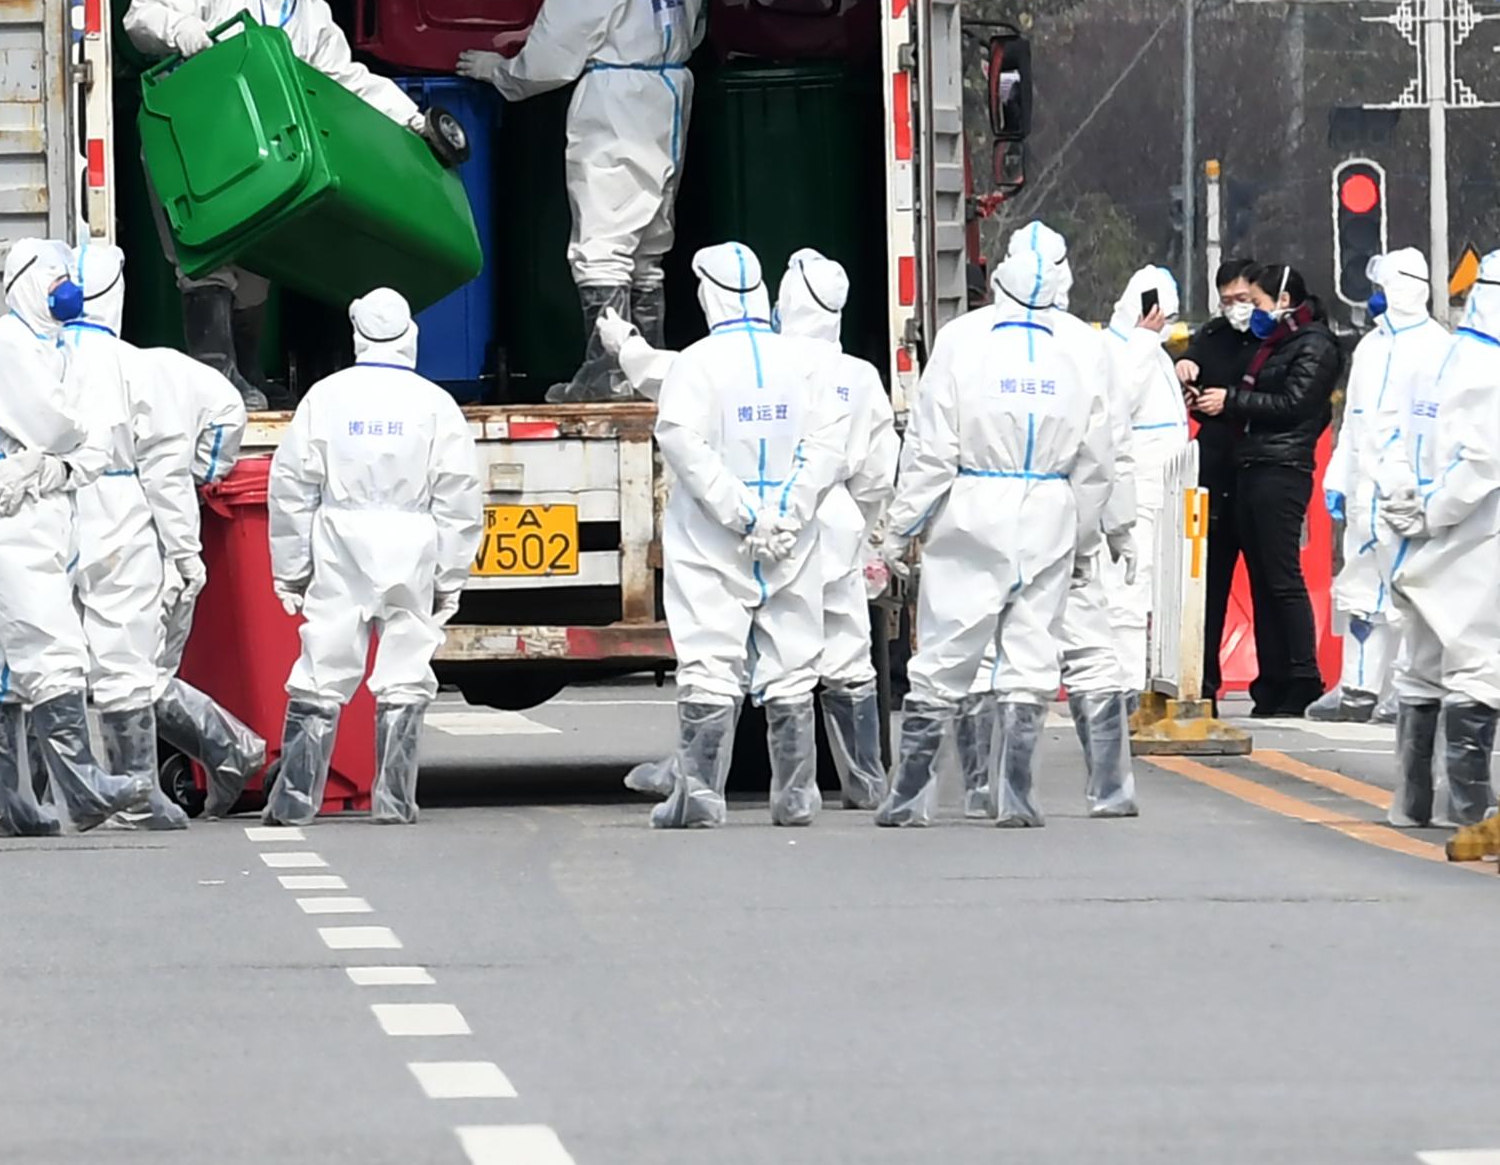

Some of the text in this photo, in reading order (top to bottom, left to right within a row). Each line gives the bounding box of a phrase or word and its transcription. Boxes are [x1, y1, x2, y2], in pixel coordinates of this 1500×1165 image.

[1000, 379, 1057, 396] 搬运班
[737, 404, 789, 422] 搬运班
[348, 420, 404, 436] 搬运班
